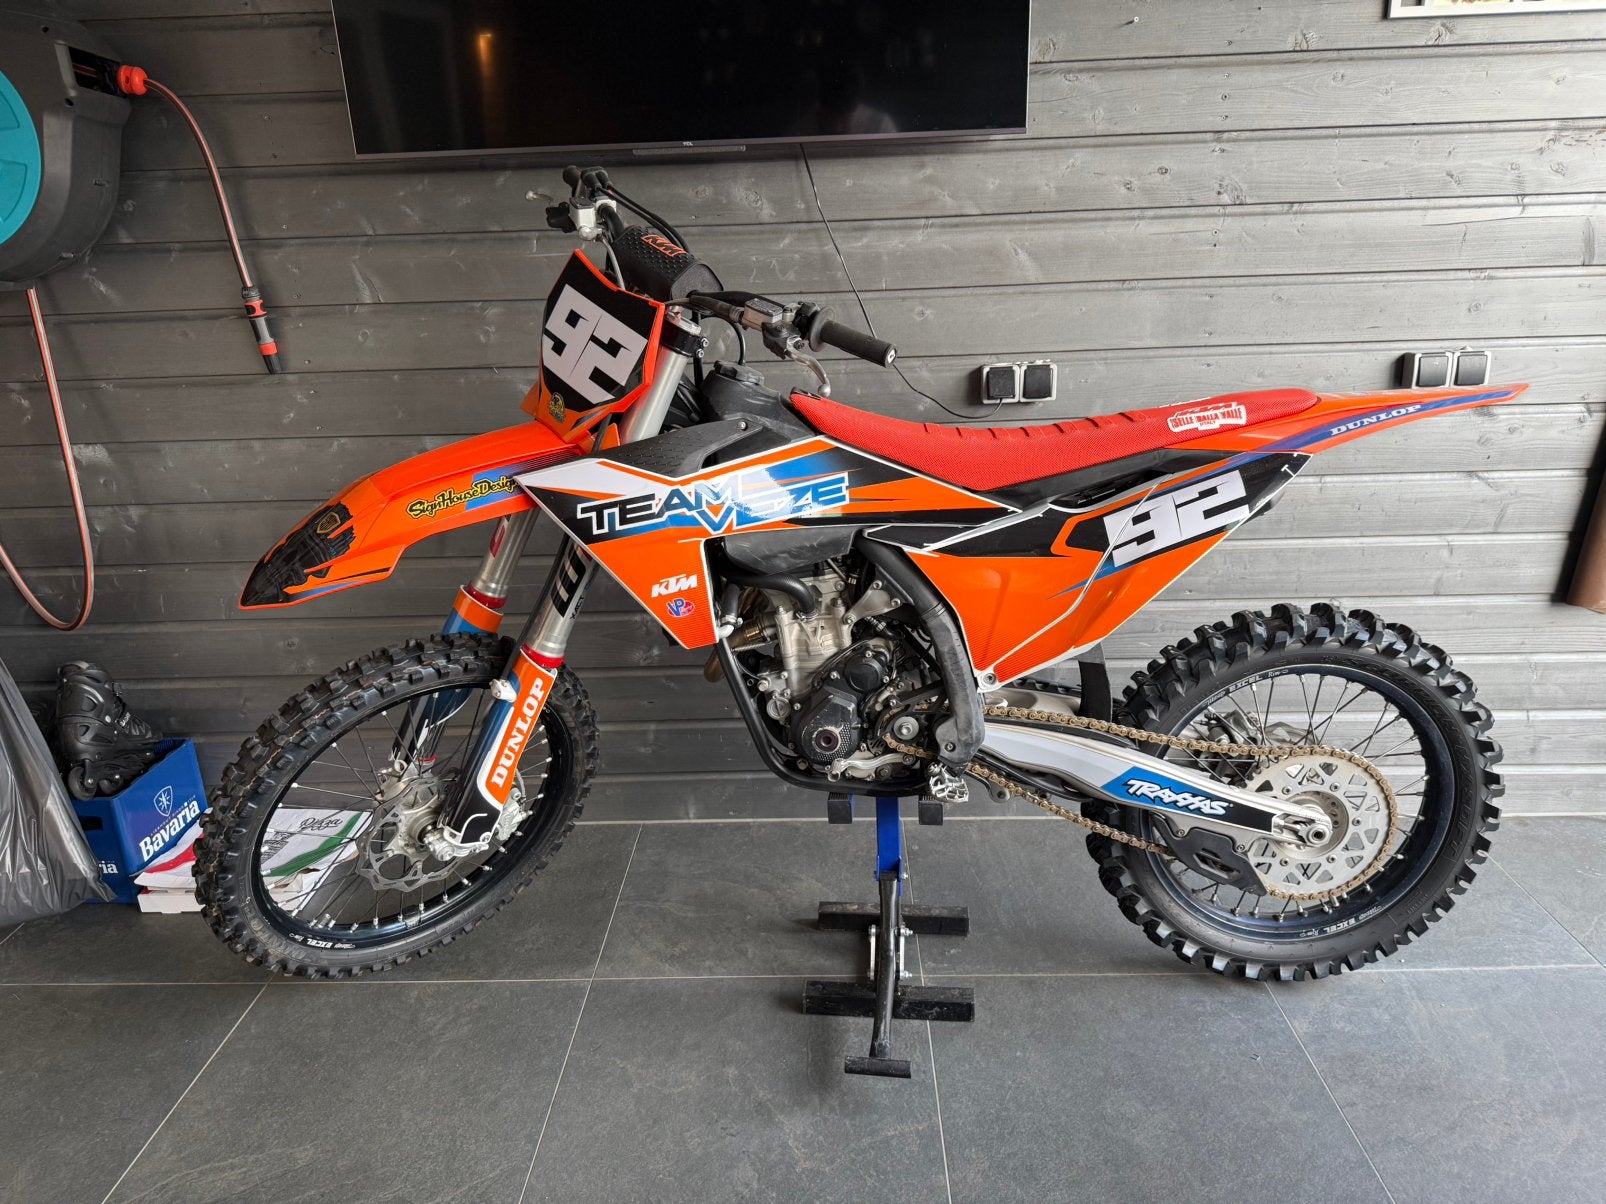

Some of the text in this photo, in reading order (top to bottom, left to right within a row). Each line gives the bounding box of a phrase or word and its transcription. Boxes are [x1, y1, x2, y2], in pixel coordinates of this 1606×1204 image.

[541, 283, 648, 404] 92
[1329, 404, 1422, 436] DUNLOP
[577, 473, 738, 535] TEAM
[1103, 469, 1250, 567] 92
[651, 573, 698, 598] KTM
[491, 677, 545, 789] DUNLOP
[1125, 778, 1230, 816] TRAXXAS
[139, 800, 200, 862] Bavaria
[306, 938, 333, 949] EXCEL
